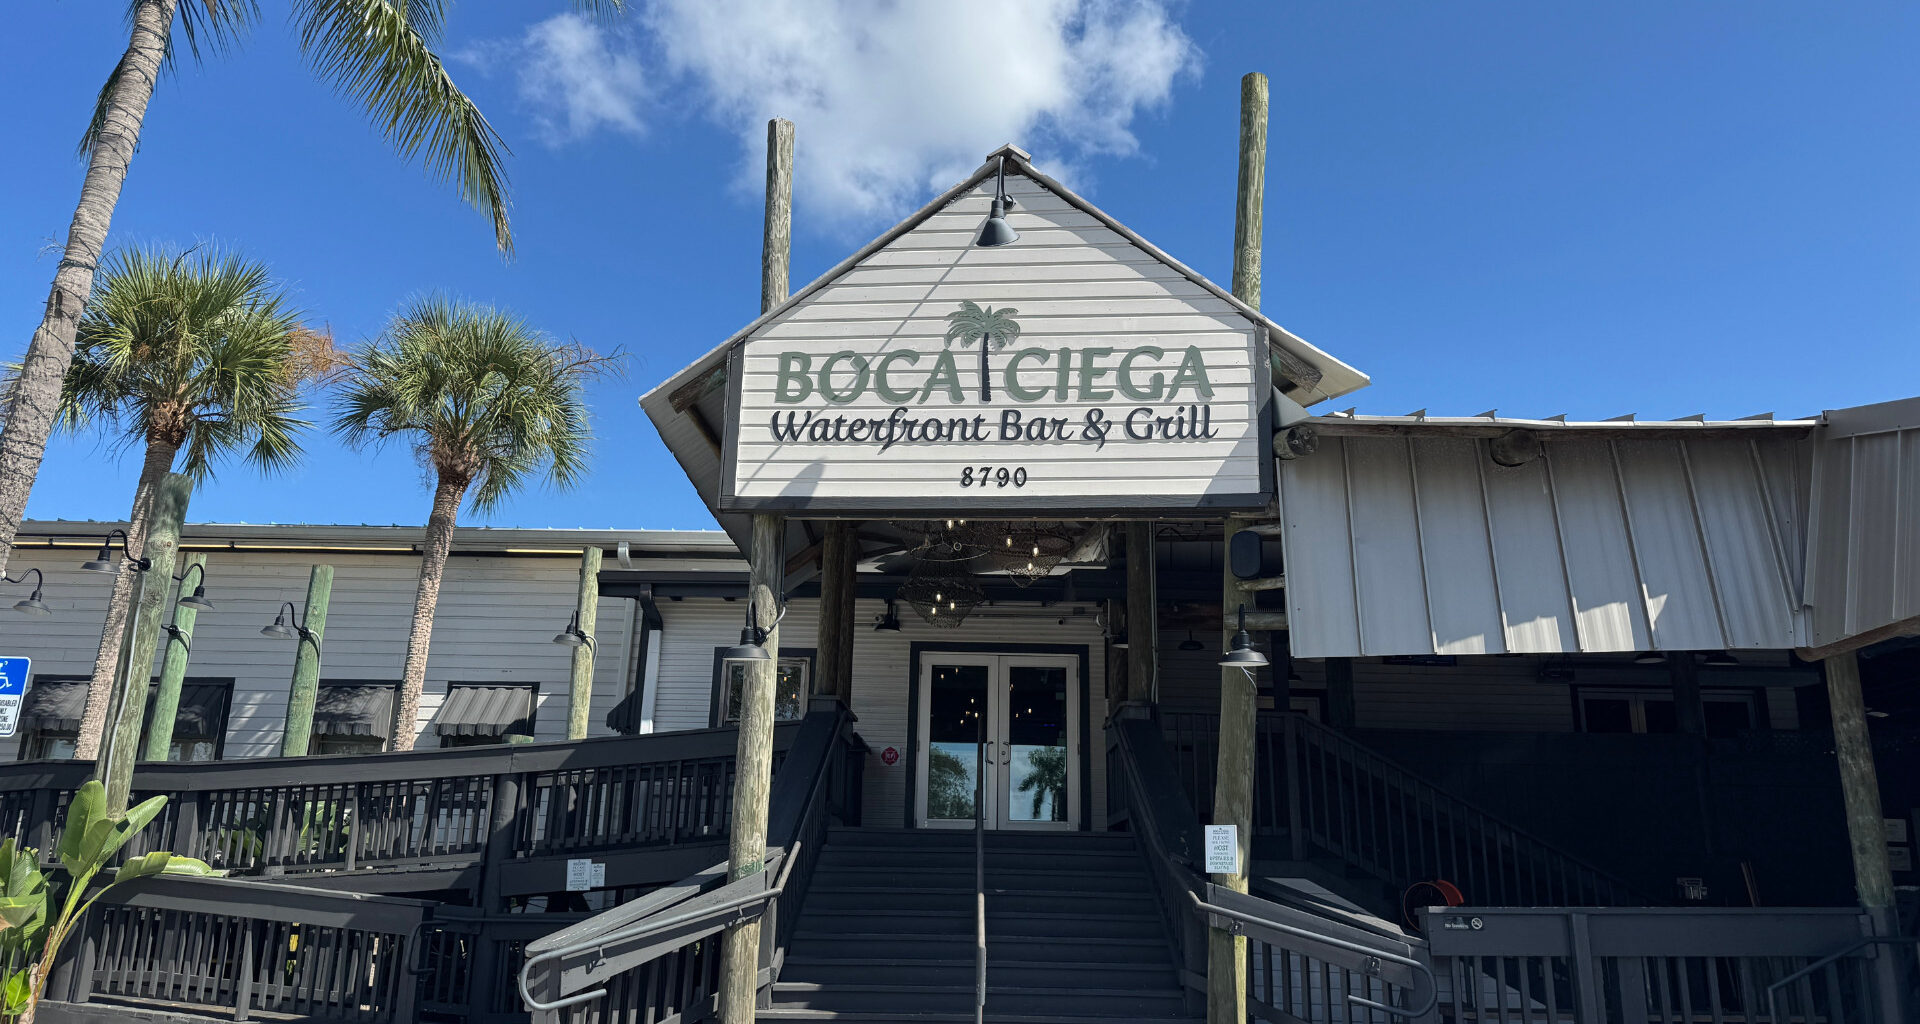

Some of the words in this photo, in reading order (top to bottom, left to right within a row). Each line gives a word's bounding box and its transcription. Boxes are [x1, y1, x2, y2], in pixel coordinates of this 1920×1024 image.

[774, 349, 964, 405] BOCA
[1004, 345, 1215, 403] CIEGA
[773, 407, 990, 456] Waterfront
[1000, 409, 1074, 441] Bar
[1082, 408, 1112, 451] &
[1126, 405, 1219, 440] Grill
[960, 466, 1029, 488] 8790
